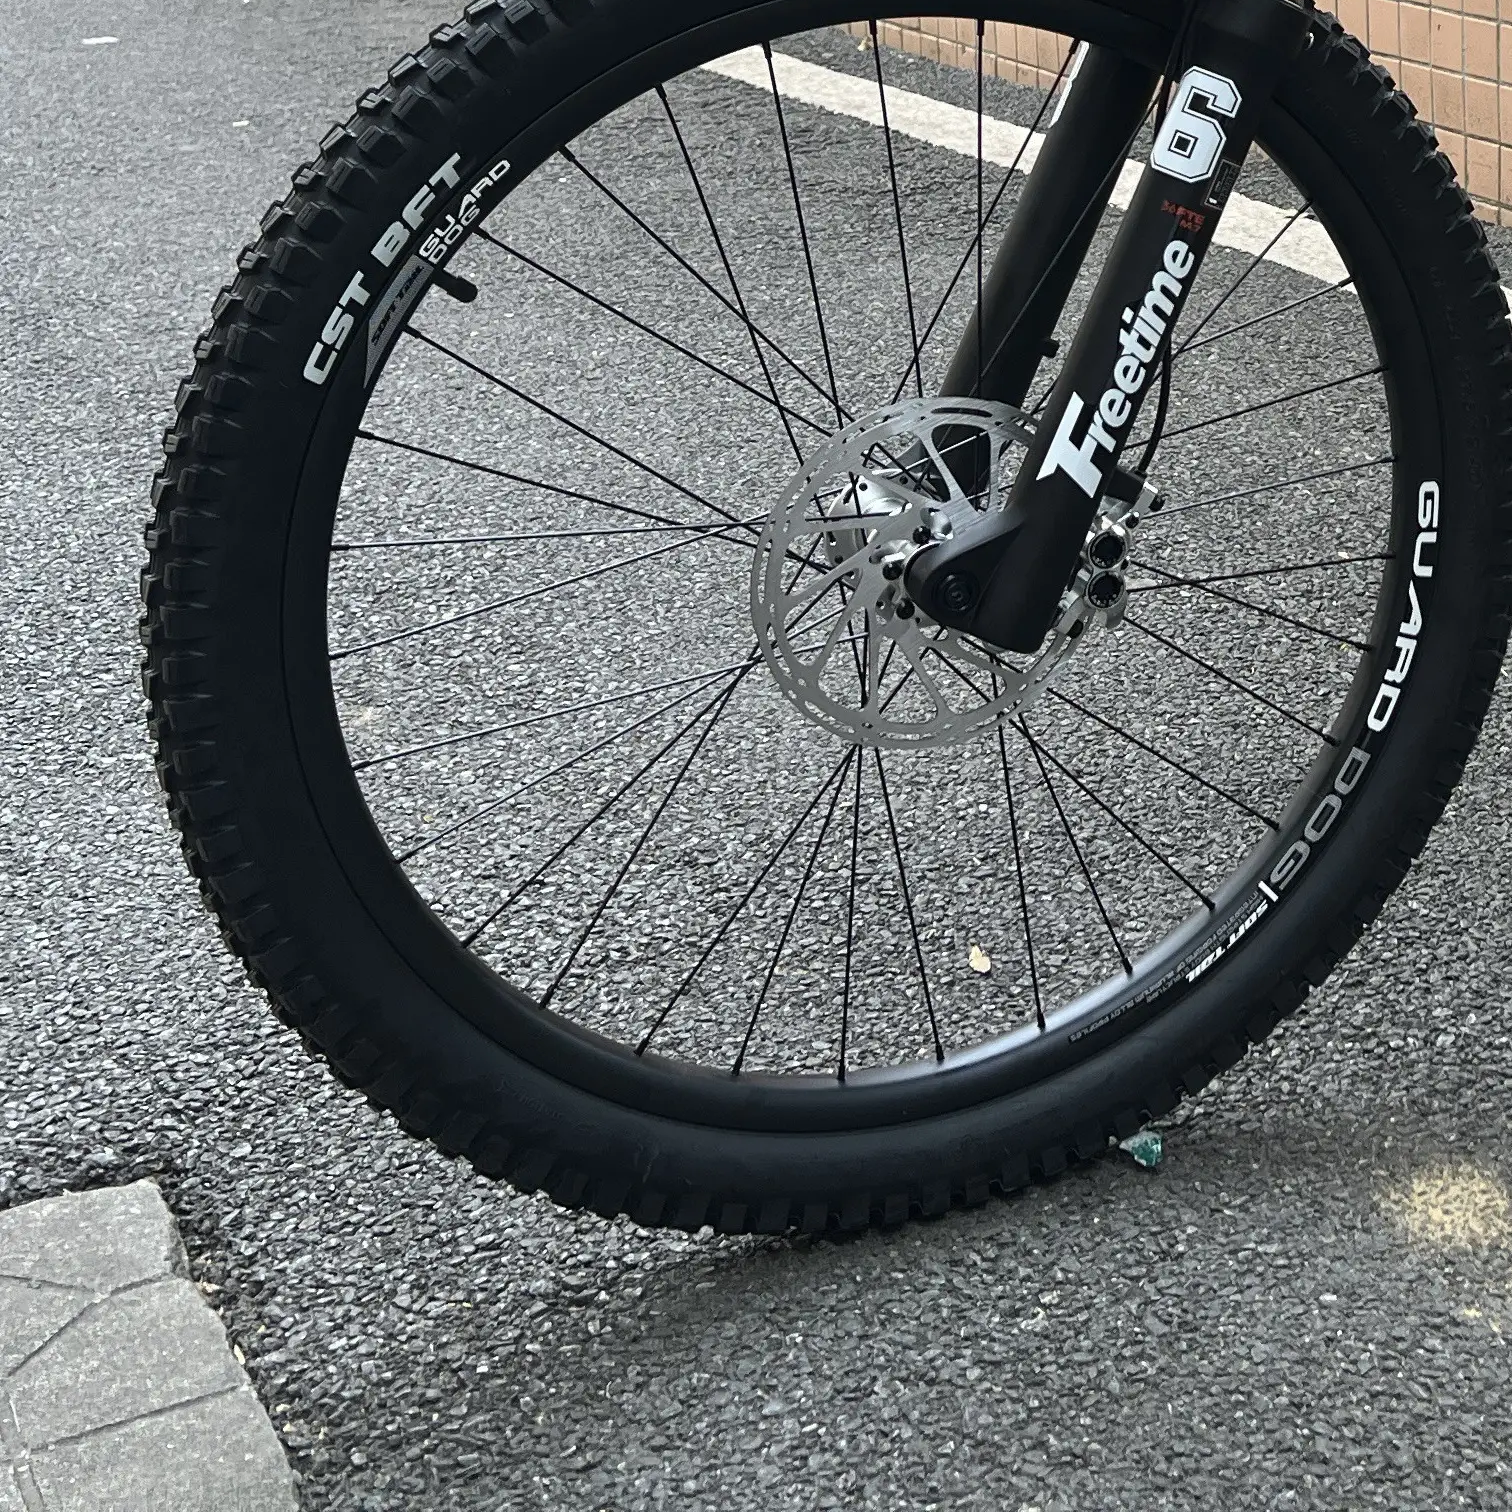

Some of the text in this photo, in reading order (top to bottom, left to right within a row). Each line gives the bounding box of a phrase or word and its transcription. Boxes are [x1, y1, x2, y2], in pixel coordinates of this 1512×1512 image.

[418, 159, 511, 261] GUARD
[1150, 65, 1242, 183] 6
[303, 152, 461, 385] CST BFT
[428, 203, 481, 265] DOG
[1036, 239, 1195, 498] Freetime
[1271, 481, 1440, 891] GUARD DOG
